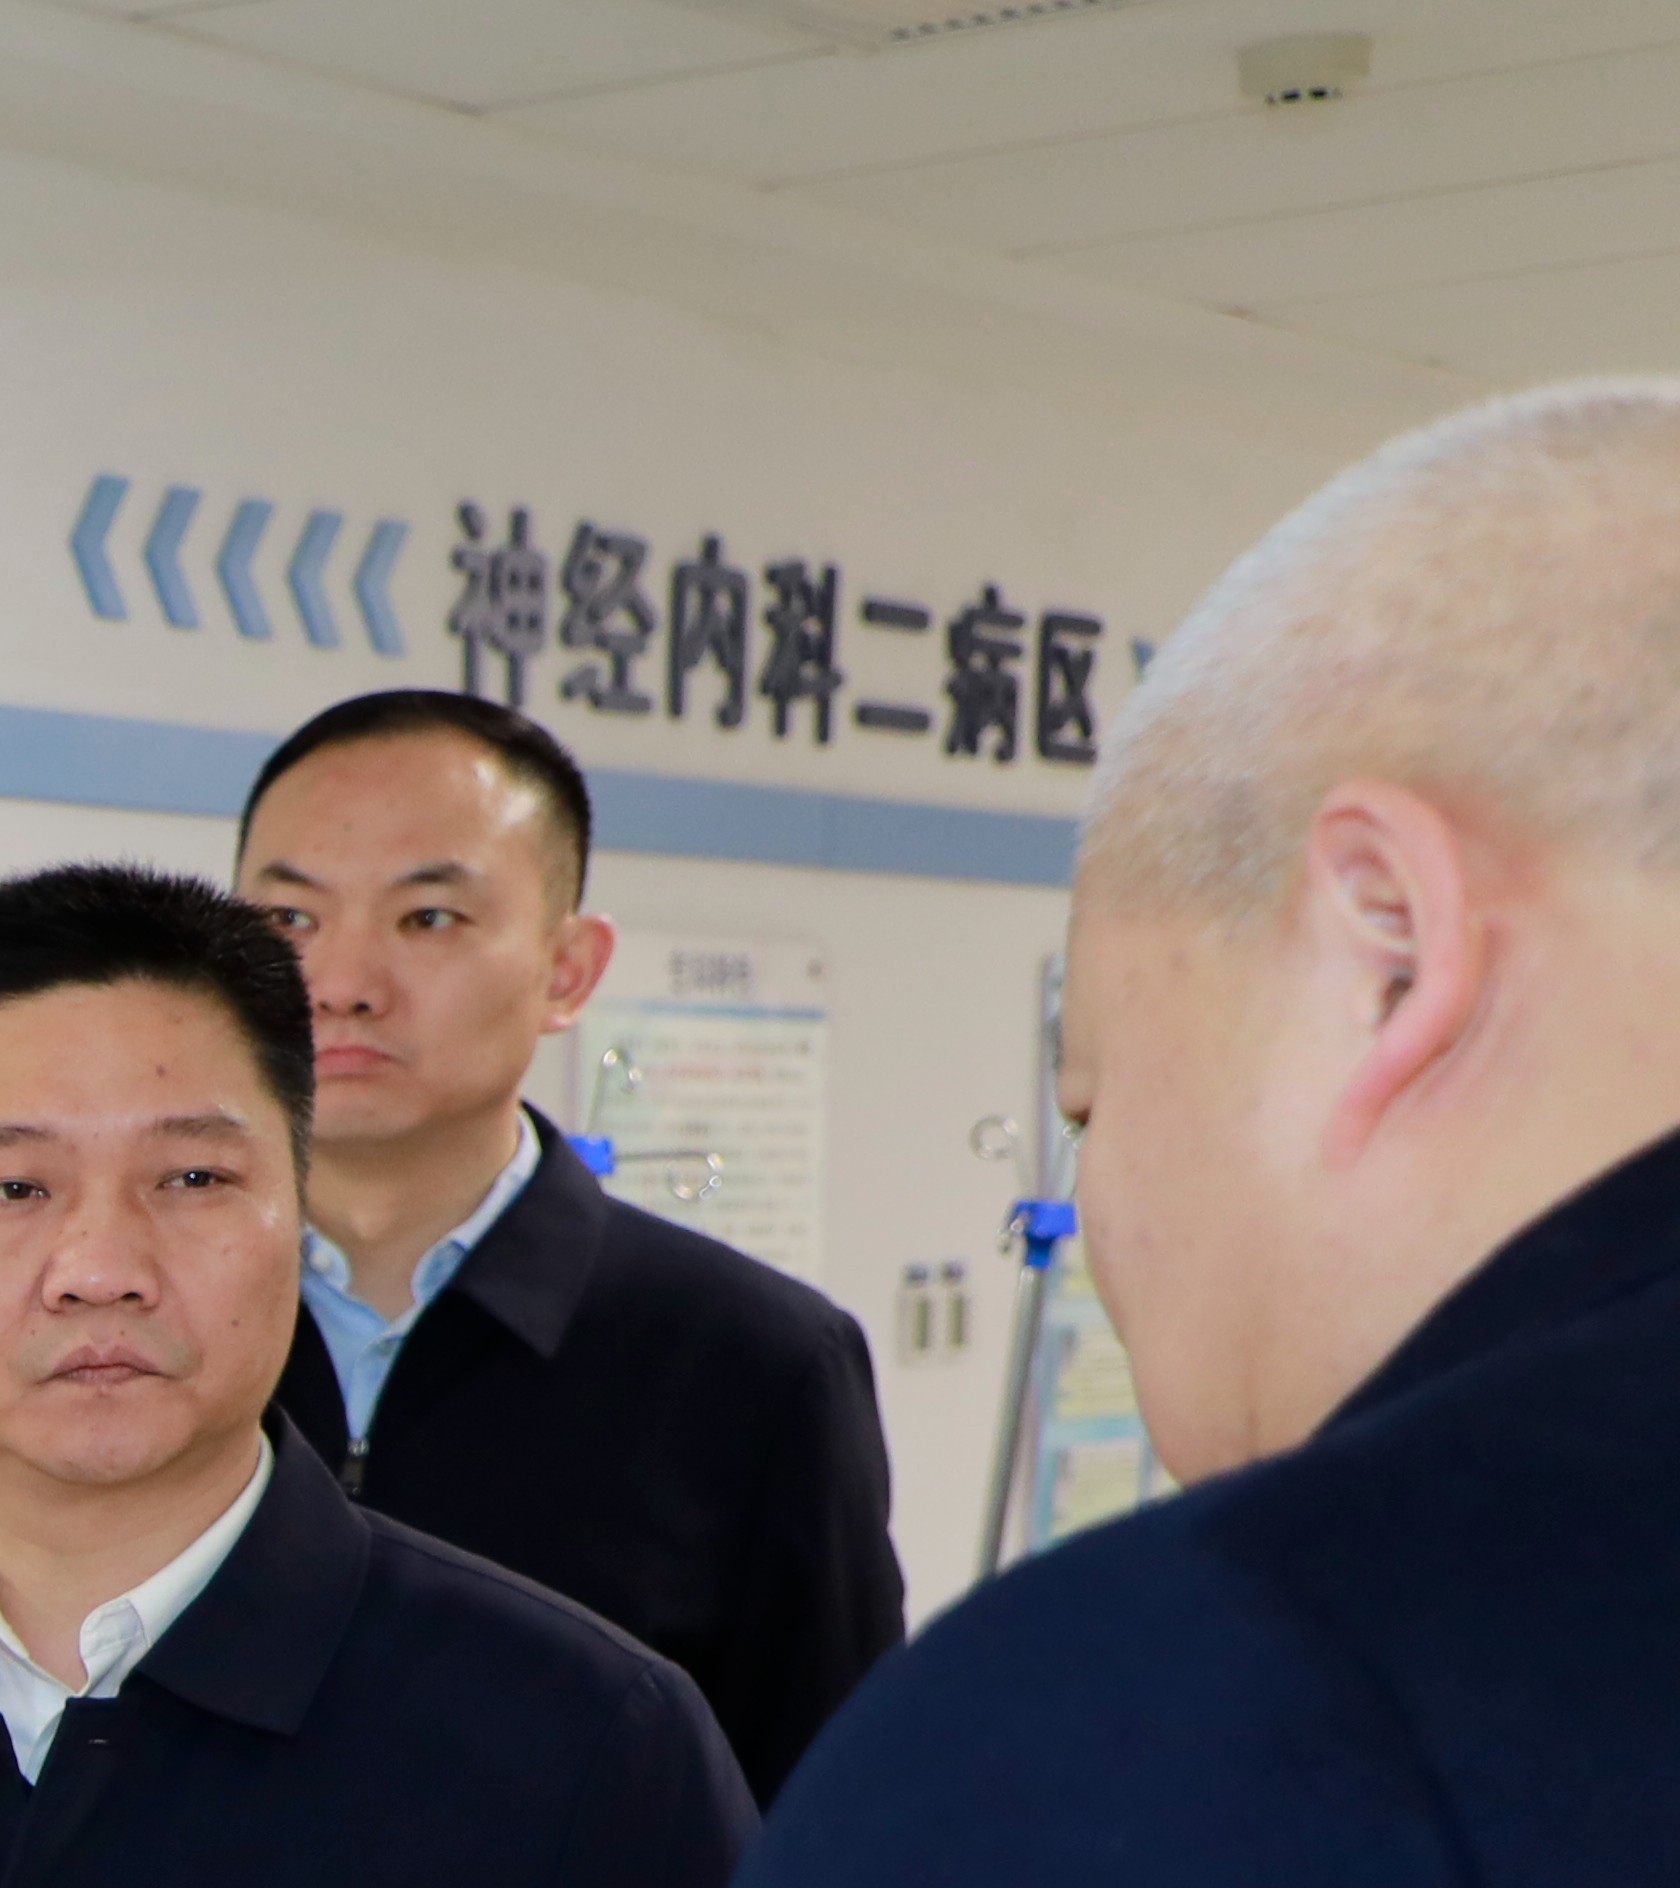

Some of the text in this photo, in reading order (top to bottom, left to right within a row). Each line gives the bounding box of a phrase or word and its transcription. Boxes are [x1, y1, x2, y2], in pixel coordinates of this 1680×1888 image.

[448, 498, 1104, 765] 神经内科二病区
